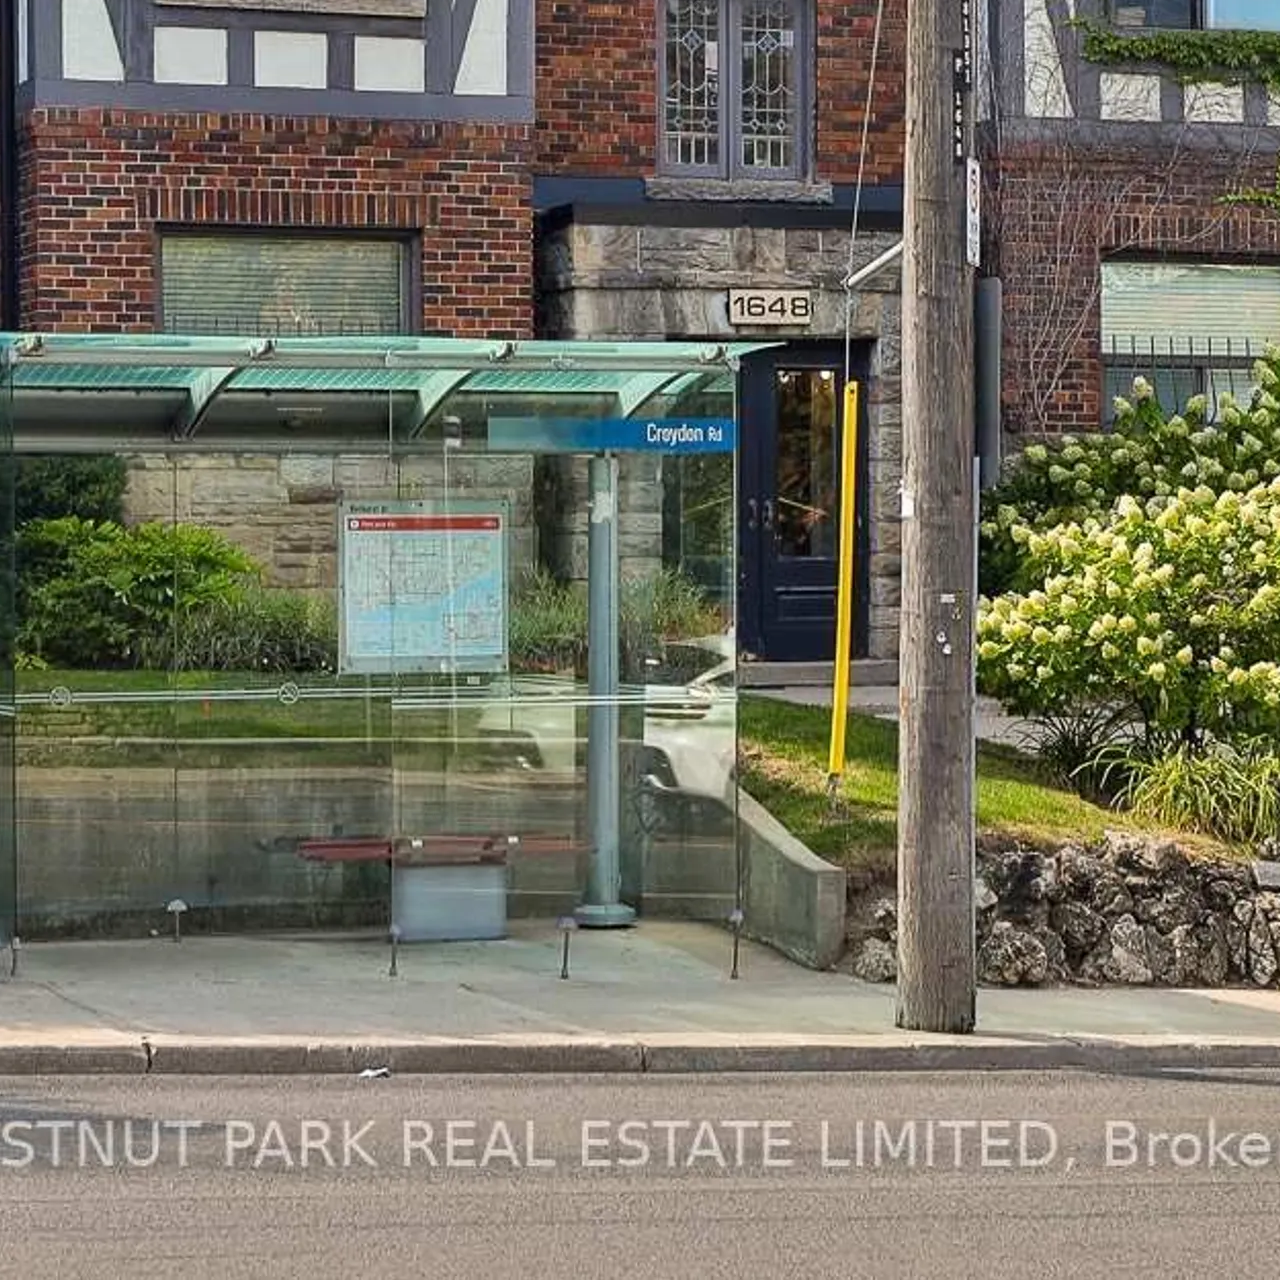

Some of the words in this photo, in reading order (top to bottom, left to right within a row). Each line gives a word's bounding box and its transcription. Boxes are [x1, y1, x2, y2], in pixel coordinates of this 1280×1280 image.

[732, 296, 810, 317] 1648
[646, 422, 704, 448] Croydon
[707, 425, 723, 442] Rd
